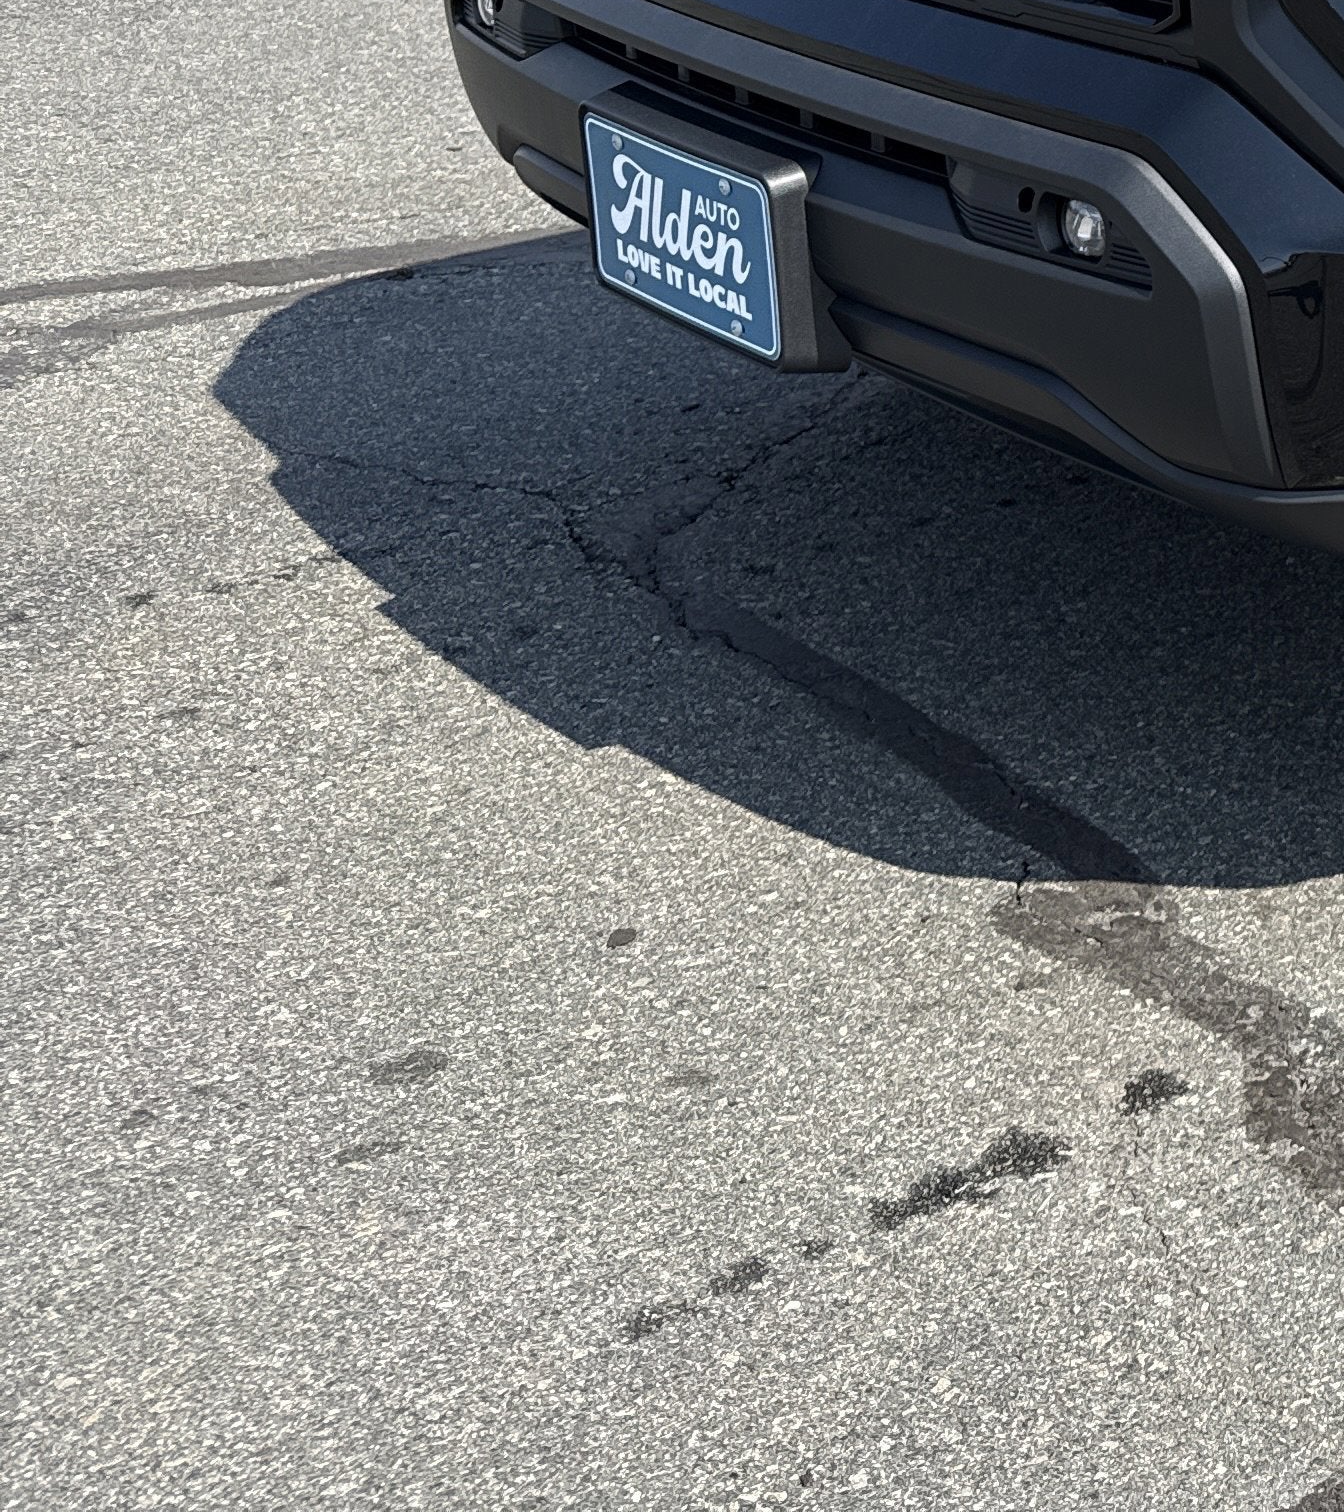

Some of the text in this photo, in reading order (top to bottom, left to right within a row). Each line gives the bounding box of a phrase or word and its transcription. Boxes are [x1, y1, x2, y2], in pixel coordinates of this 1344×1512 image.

[611, 154, 751, 284] Alden
[694, 195, 741, 231] AUTO
[616, 238, 752, 321] LOVE IT LOCAL
